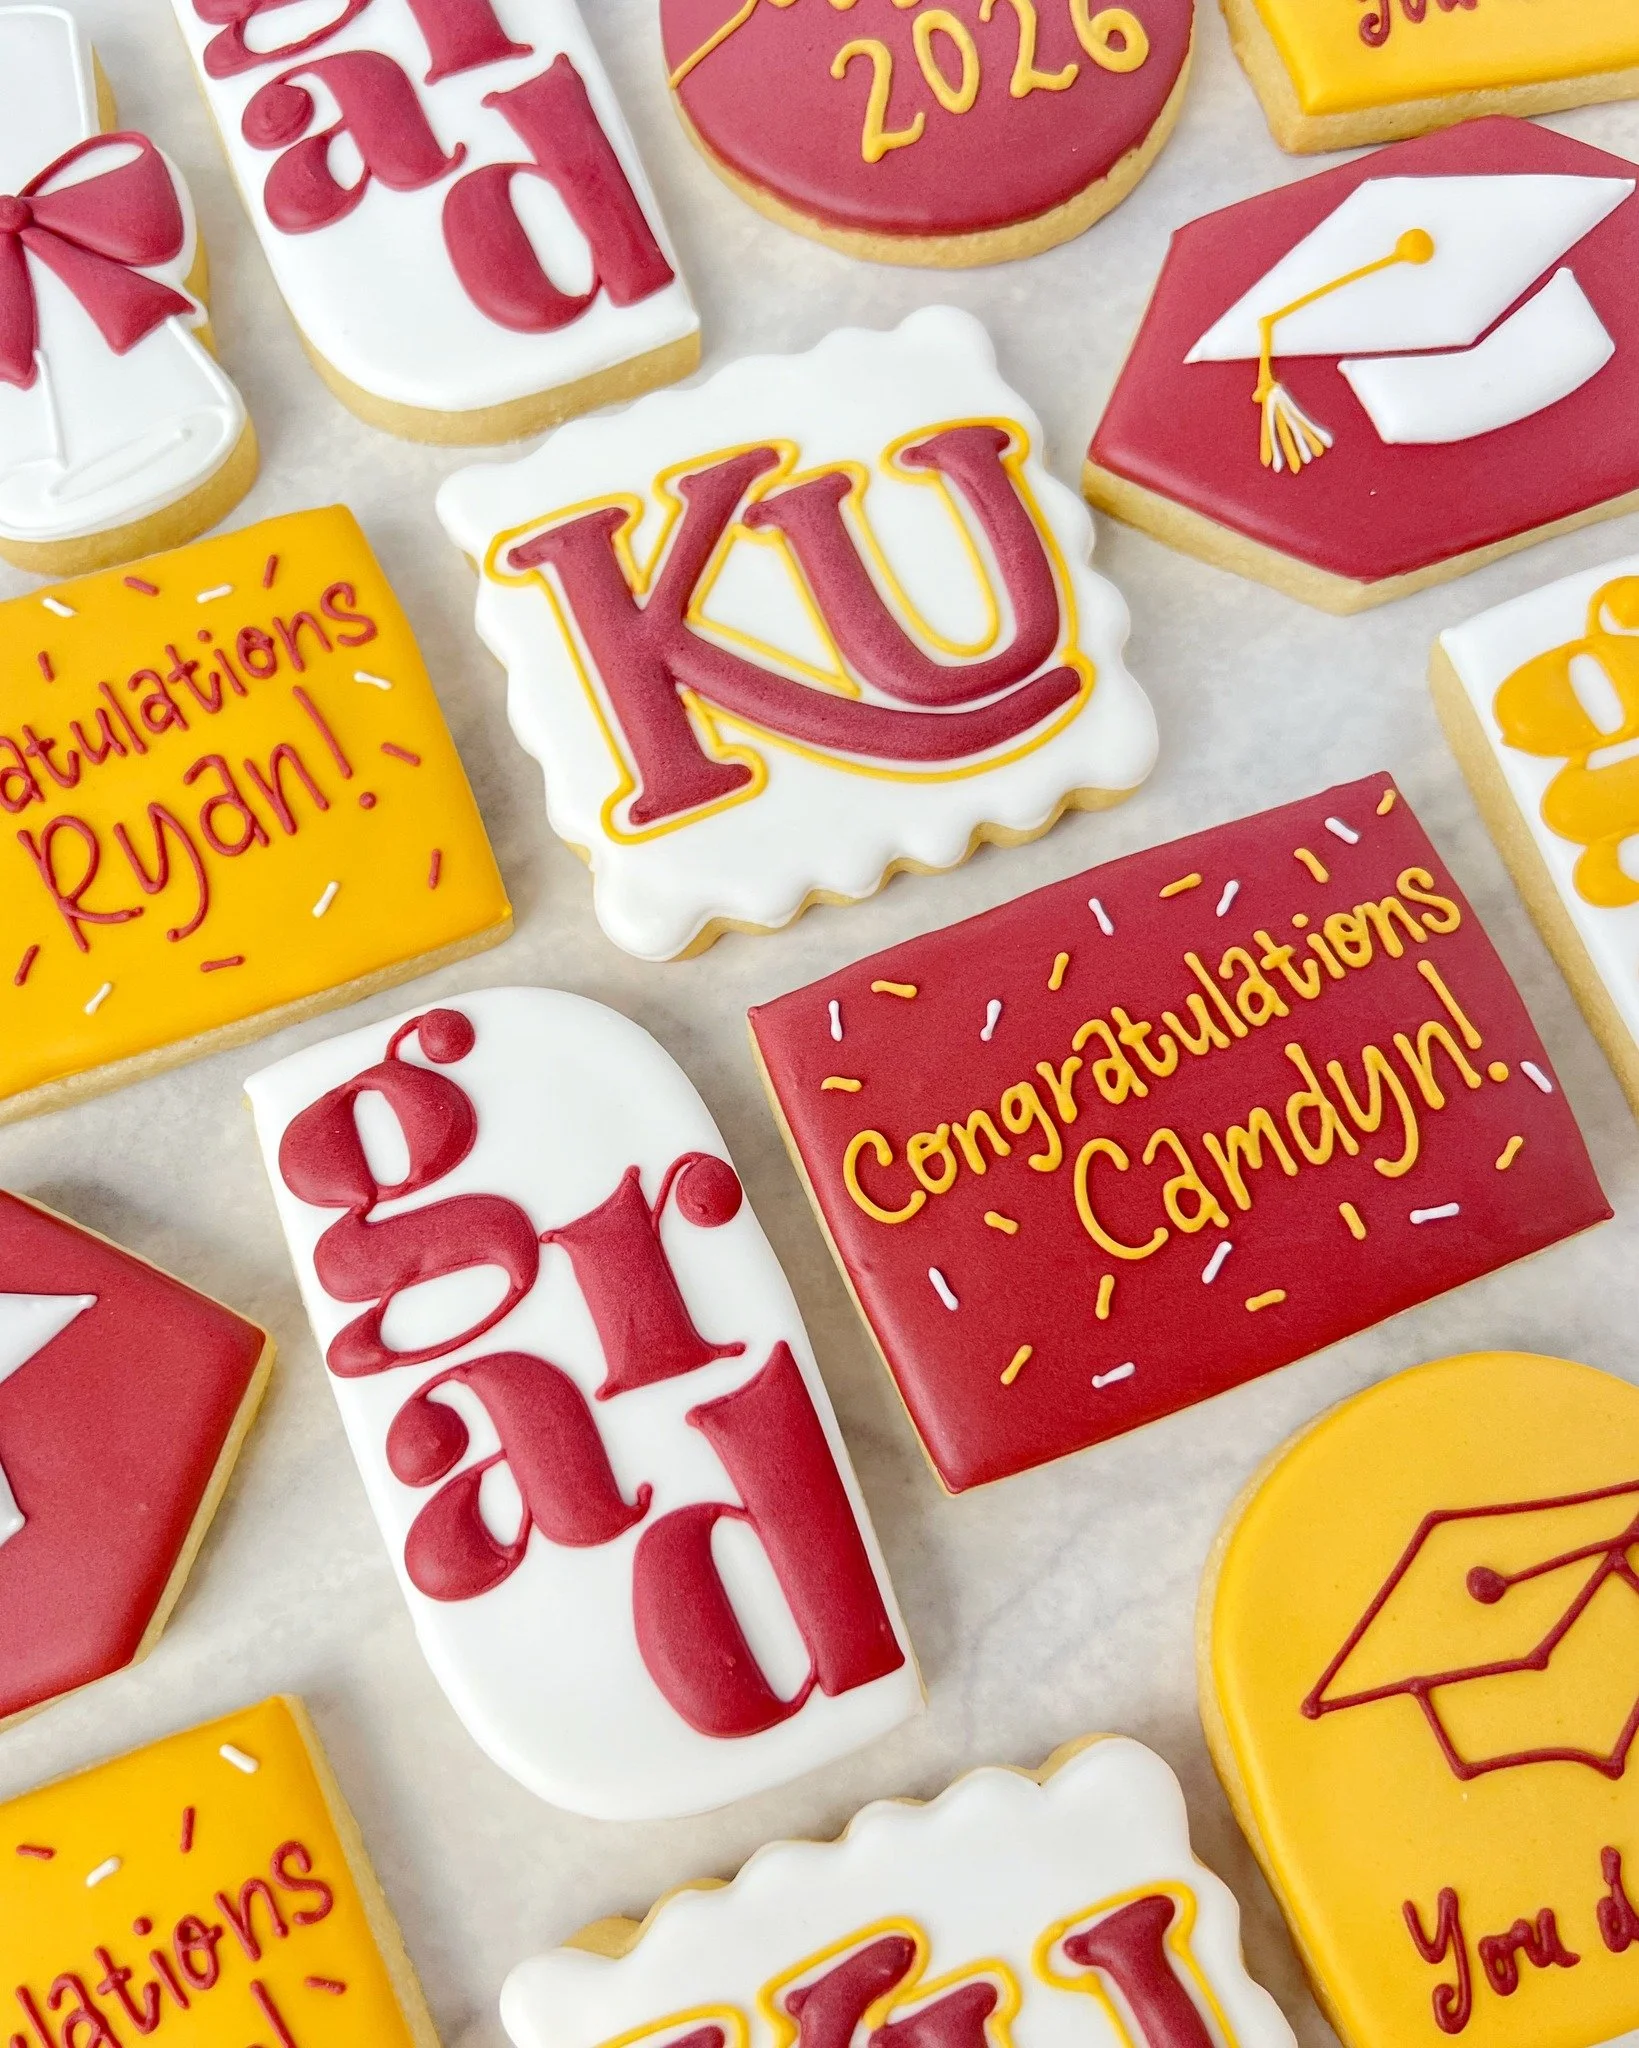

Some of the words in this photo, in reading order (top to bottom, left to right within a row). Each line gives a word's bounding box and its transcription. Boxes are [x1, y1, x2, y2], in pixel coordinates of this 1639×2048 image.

[830, 0, 1150, 164] 2026
[506, 424, 1082, 827] KU
[16, 686, 378, 954] Ryan!
[842, 866, 1462, 1225] Congratulations
[1072, 958, 1510, 1262] Camdyn!
[8, 1839, 334, 2048] lations
[1401, 1886, 1583, 2036] You
